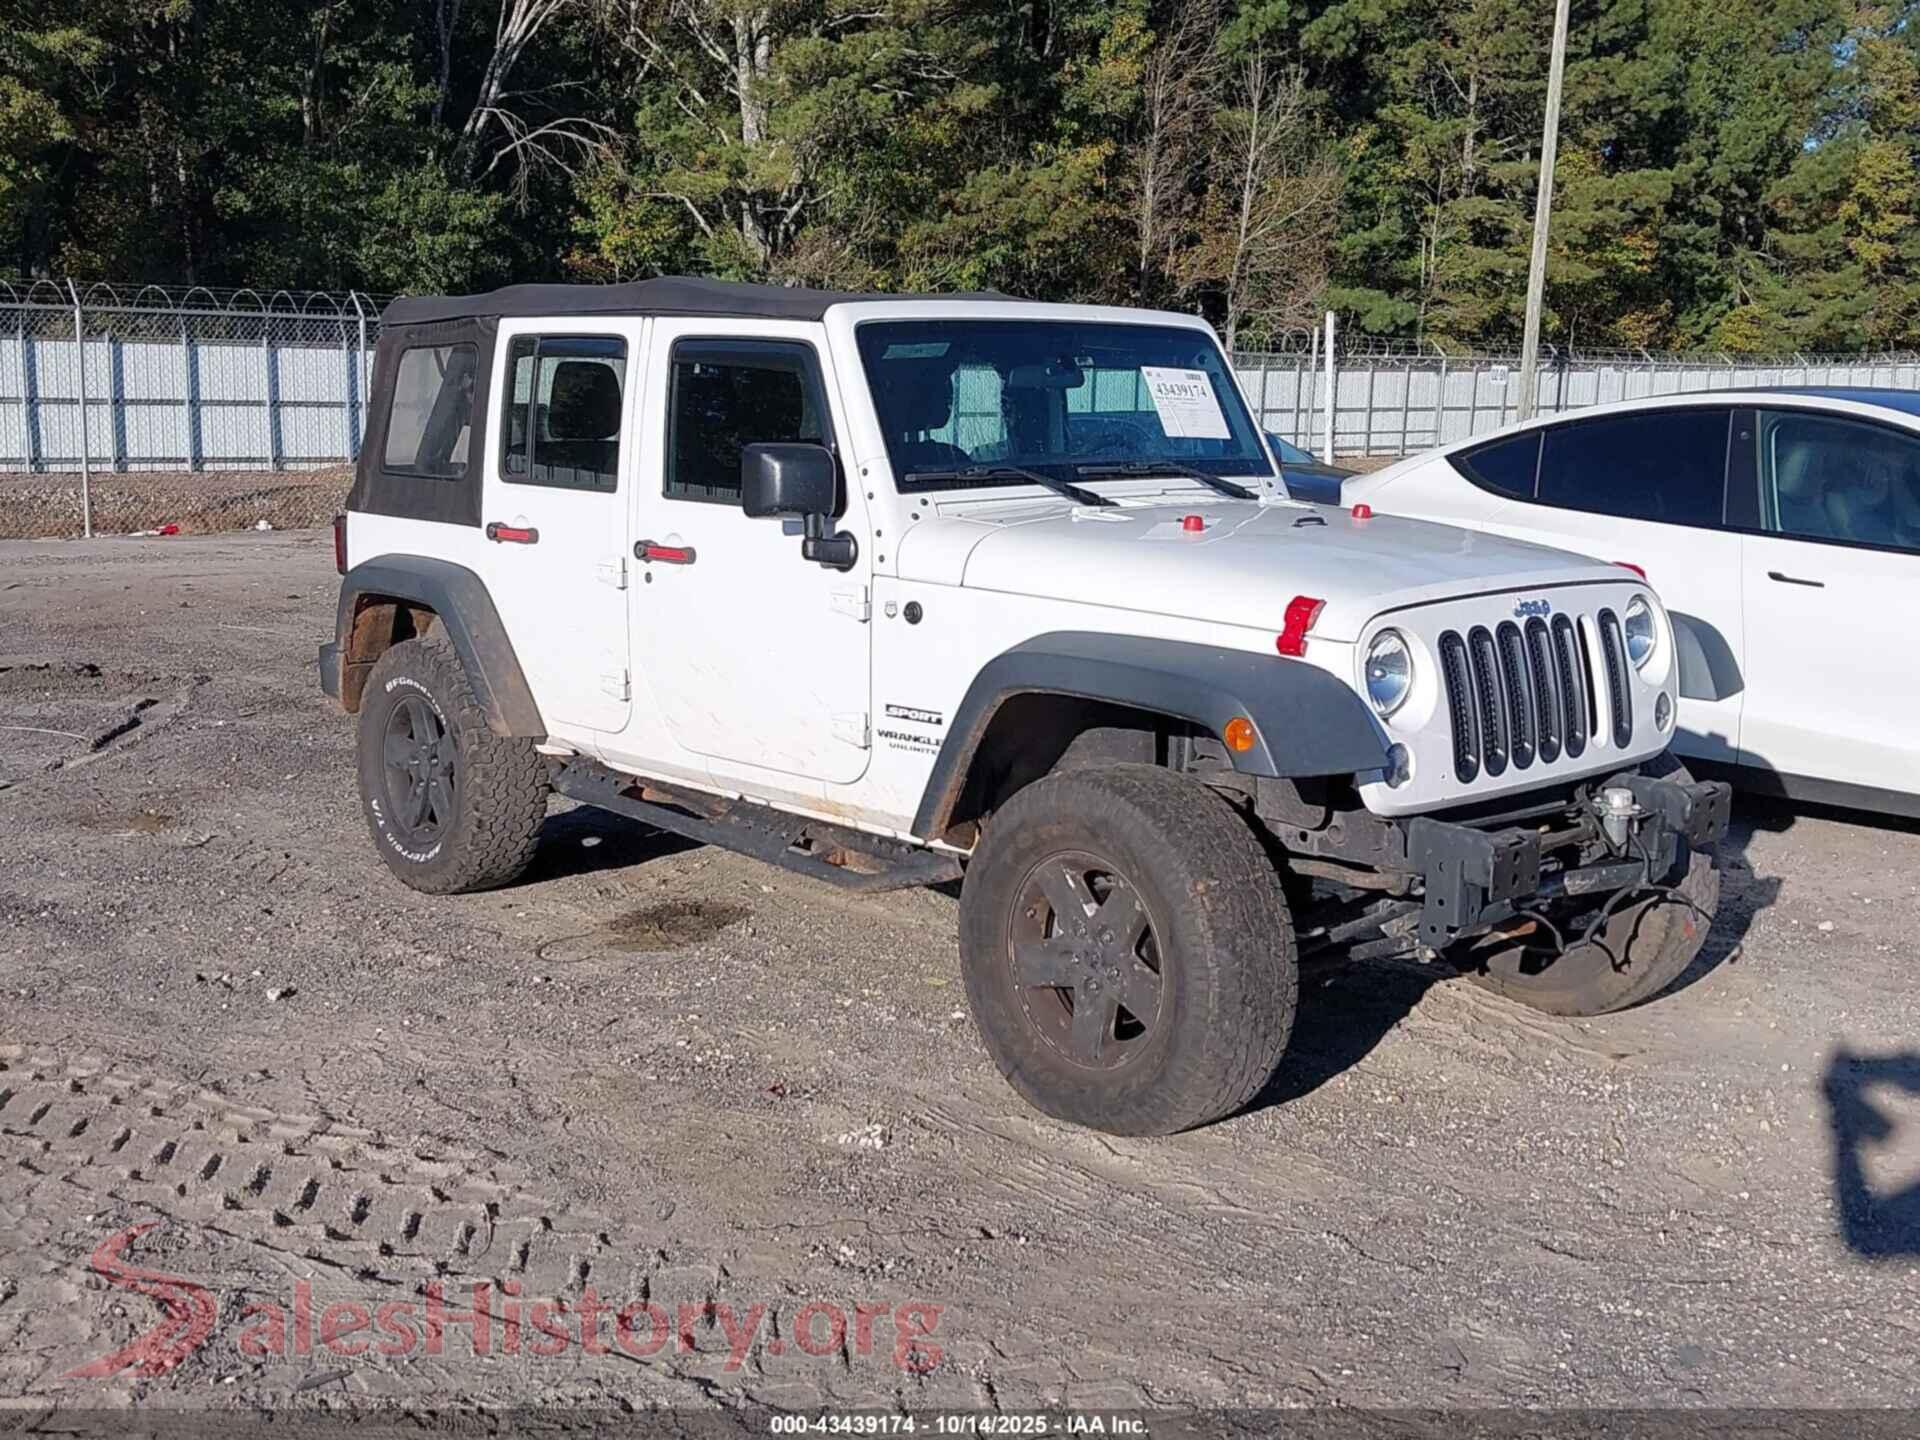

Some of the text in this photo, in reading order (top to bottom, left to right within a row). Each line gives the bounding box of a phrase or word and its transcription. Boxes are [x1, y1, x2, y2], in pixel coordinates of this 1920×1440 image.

[1156, 383, 1207, 398] 43439174
[1513, 597, 1551, 618] Jeep
[886, 704, 942, 725] SPORT
[877, 729, 944, 746] WRANGLE
[889, 742, 937, 755] UNLIMITE
